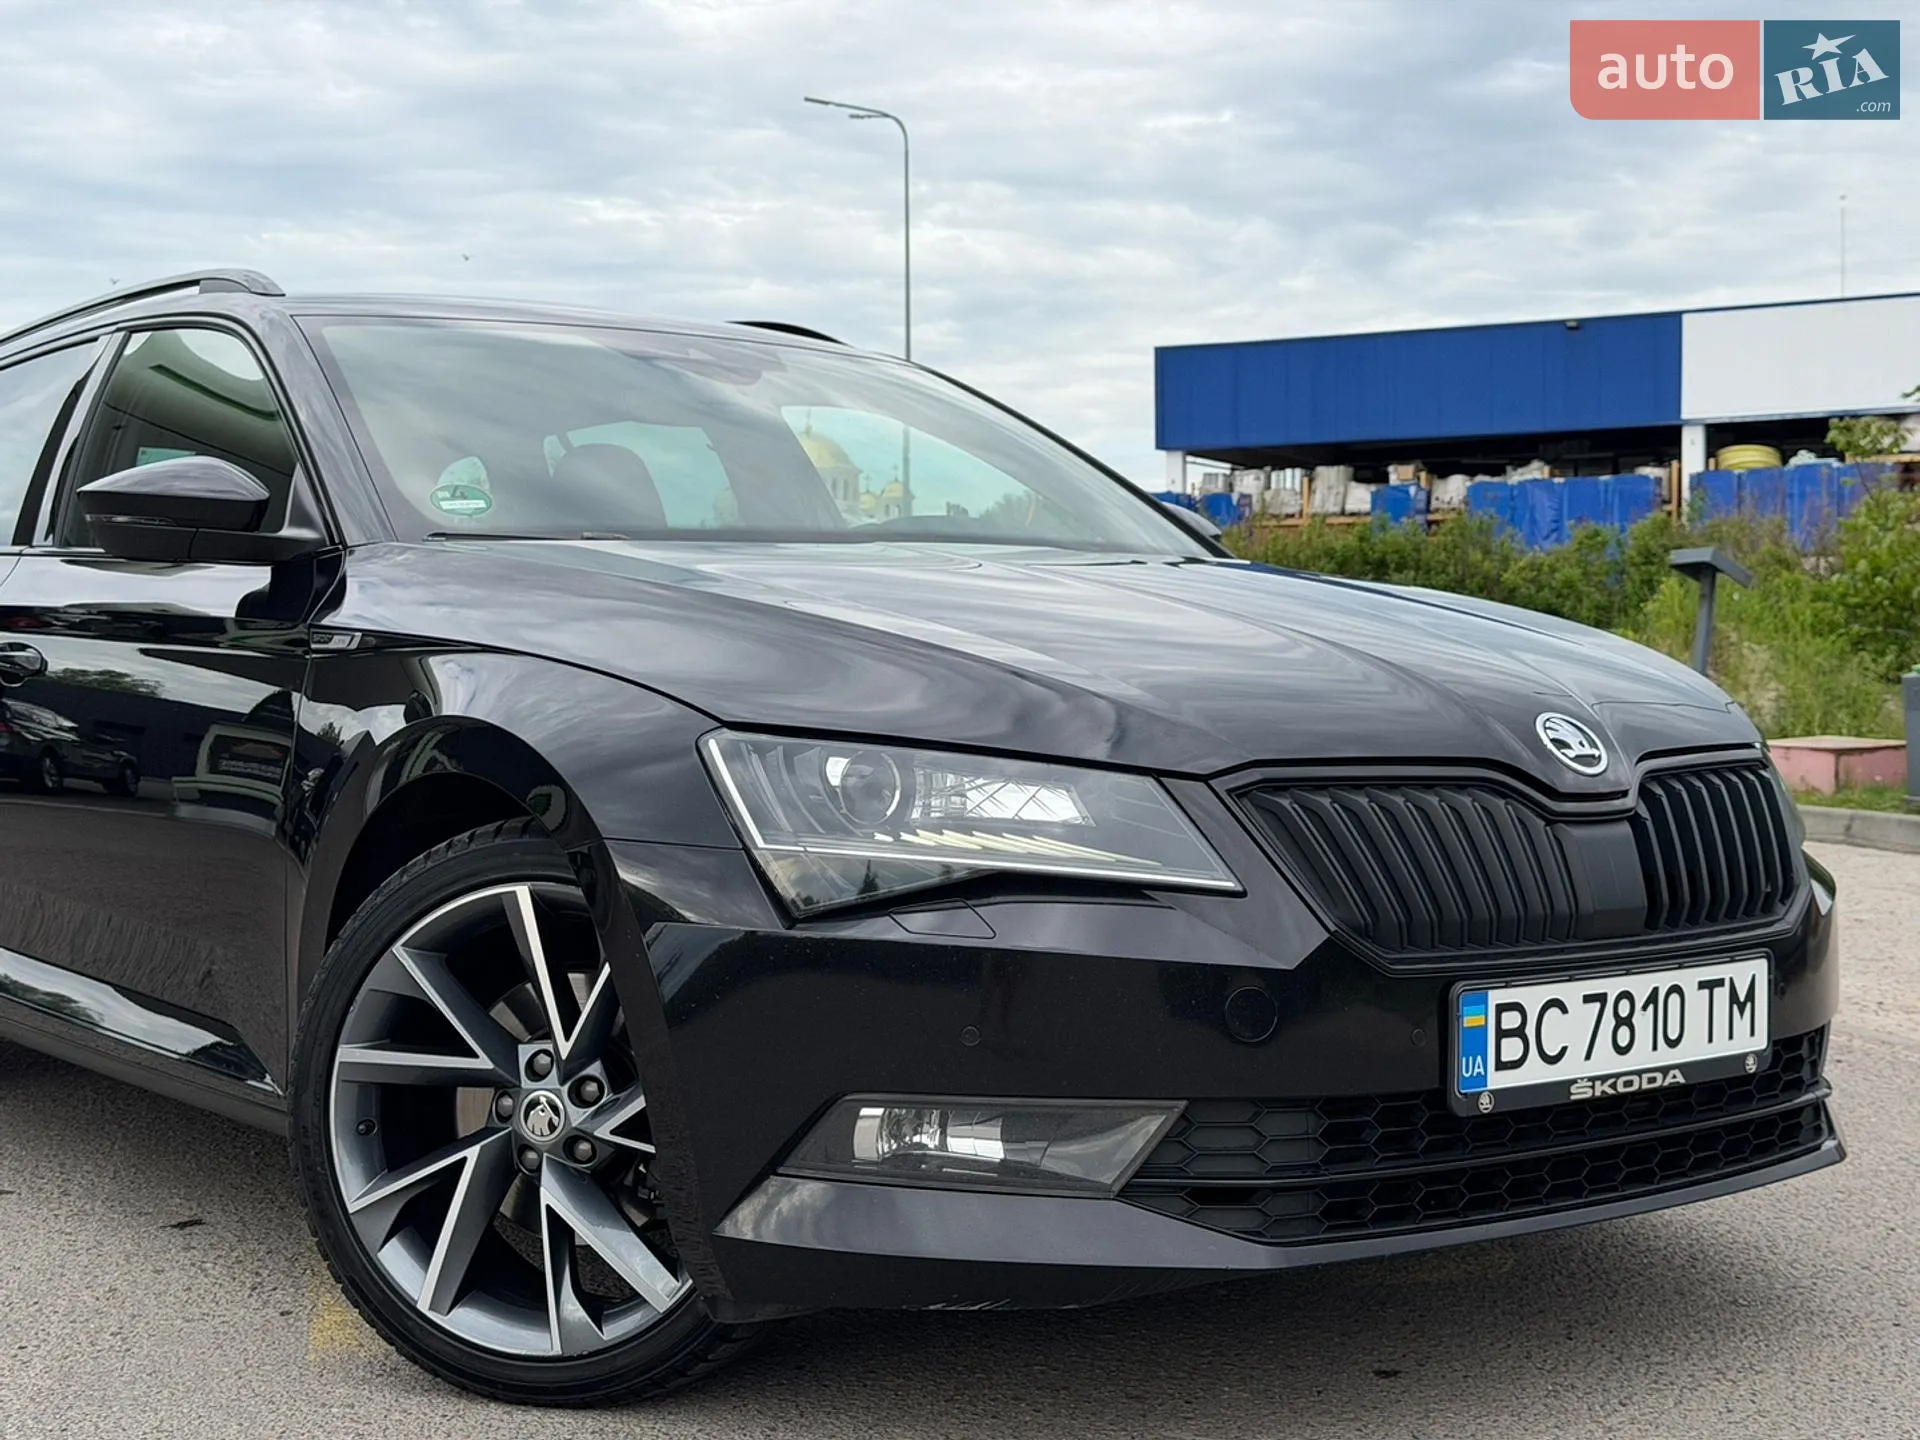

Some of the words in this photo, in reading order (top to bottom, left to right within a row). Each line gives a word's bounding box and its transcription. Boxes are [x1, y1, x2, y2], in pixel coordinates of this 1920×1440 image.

[1494, 997, 1570, 1072] BC
[1582, 983, 1686, 1061] 7810
[1697, 973, 1756, 1044] TM
[1461, 1054, 1485, 1078] UA
[1569, 1068, 1686, 1101] ŠKODA
